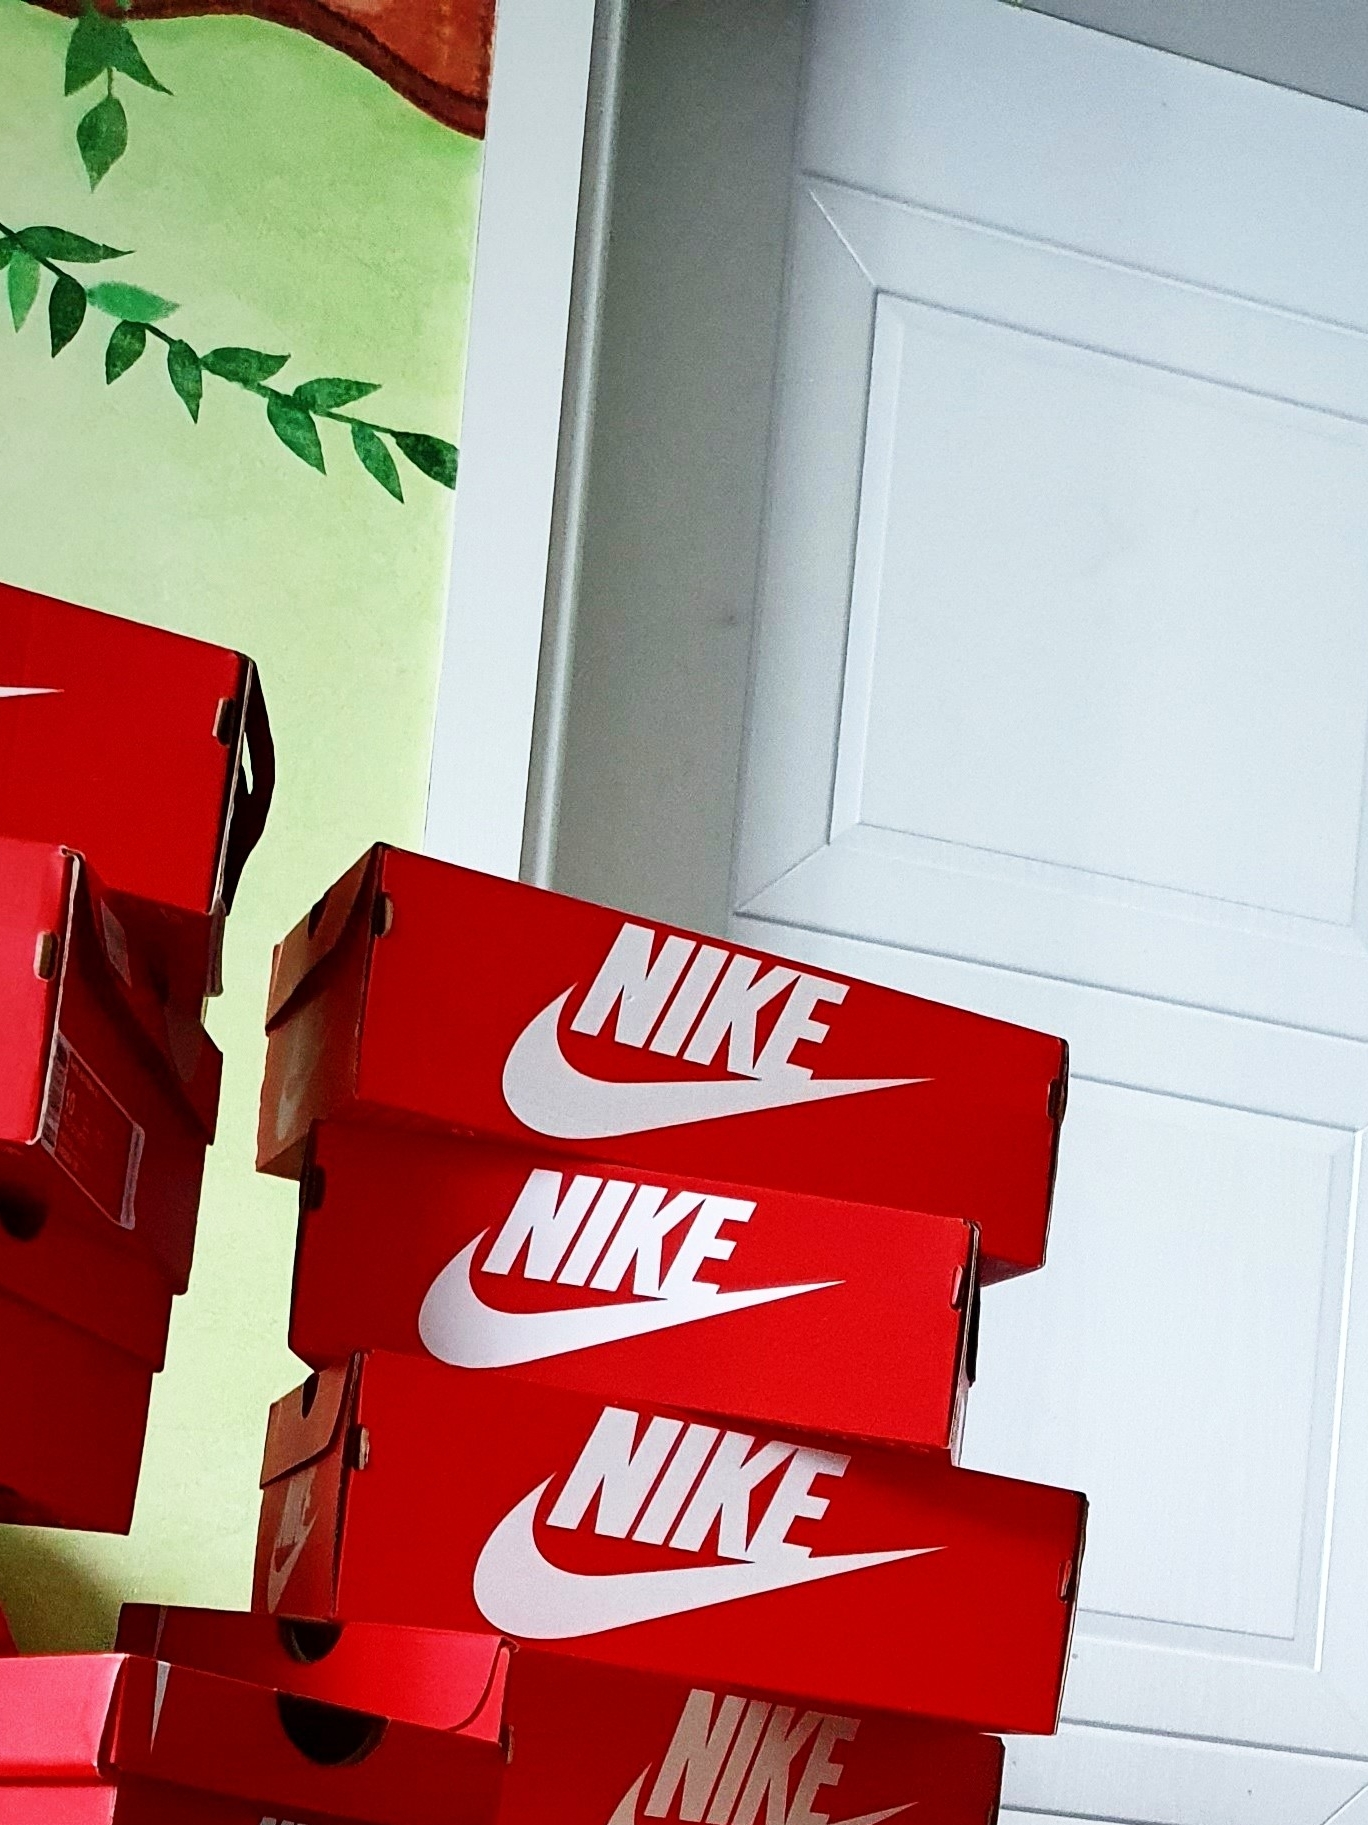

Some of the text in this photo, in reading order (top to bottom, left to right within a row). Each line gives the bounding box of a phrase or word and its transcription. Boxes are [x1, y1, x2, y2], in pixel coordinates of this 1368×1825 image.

[569, 921, 850, 1081] NIKE
[481, 1168, 758, 1300] NIKE
[545, 1405, 852, 1563] NIKE
